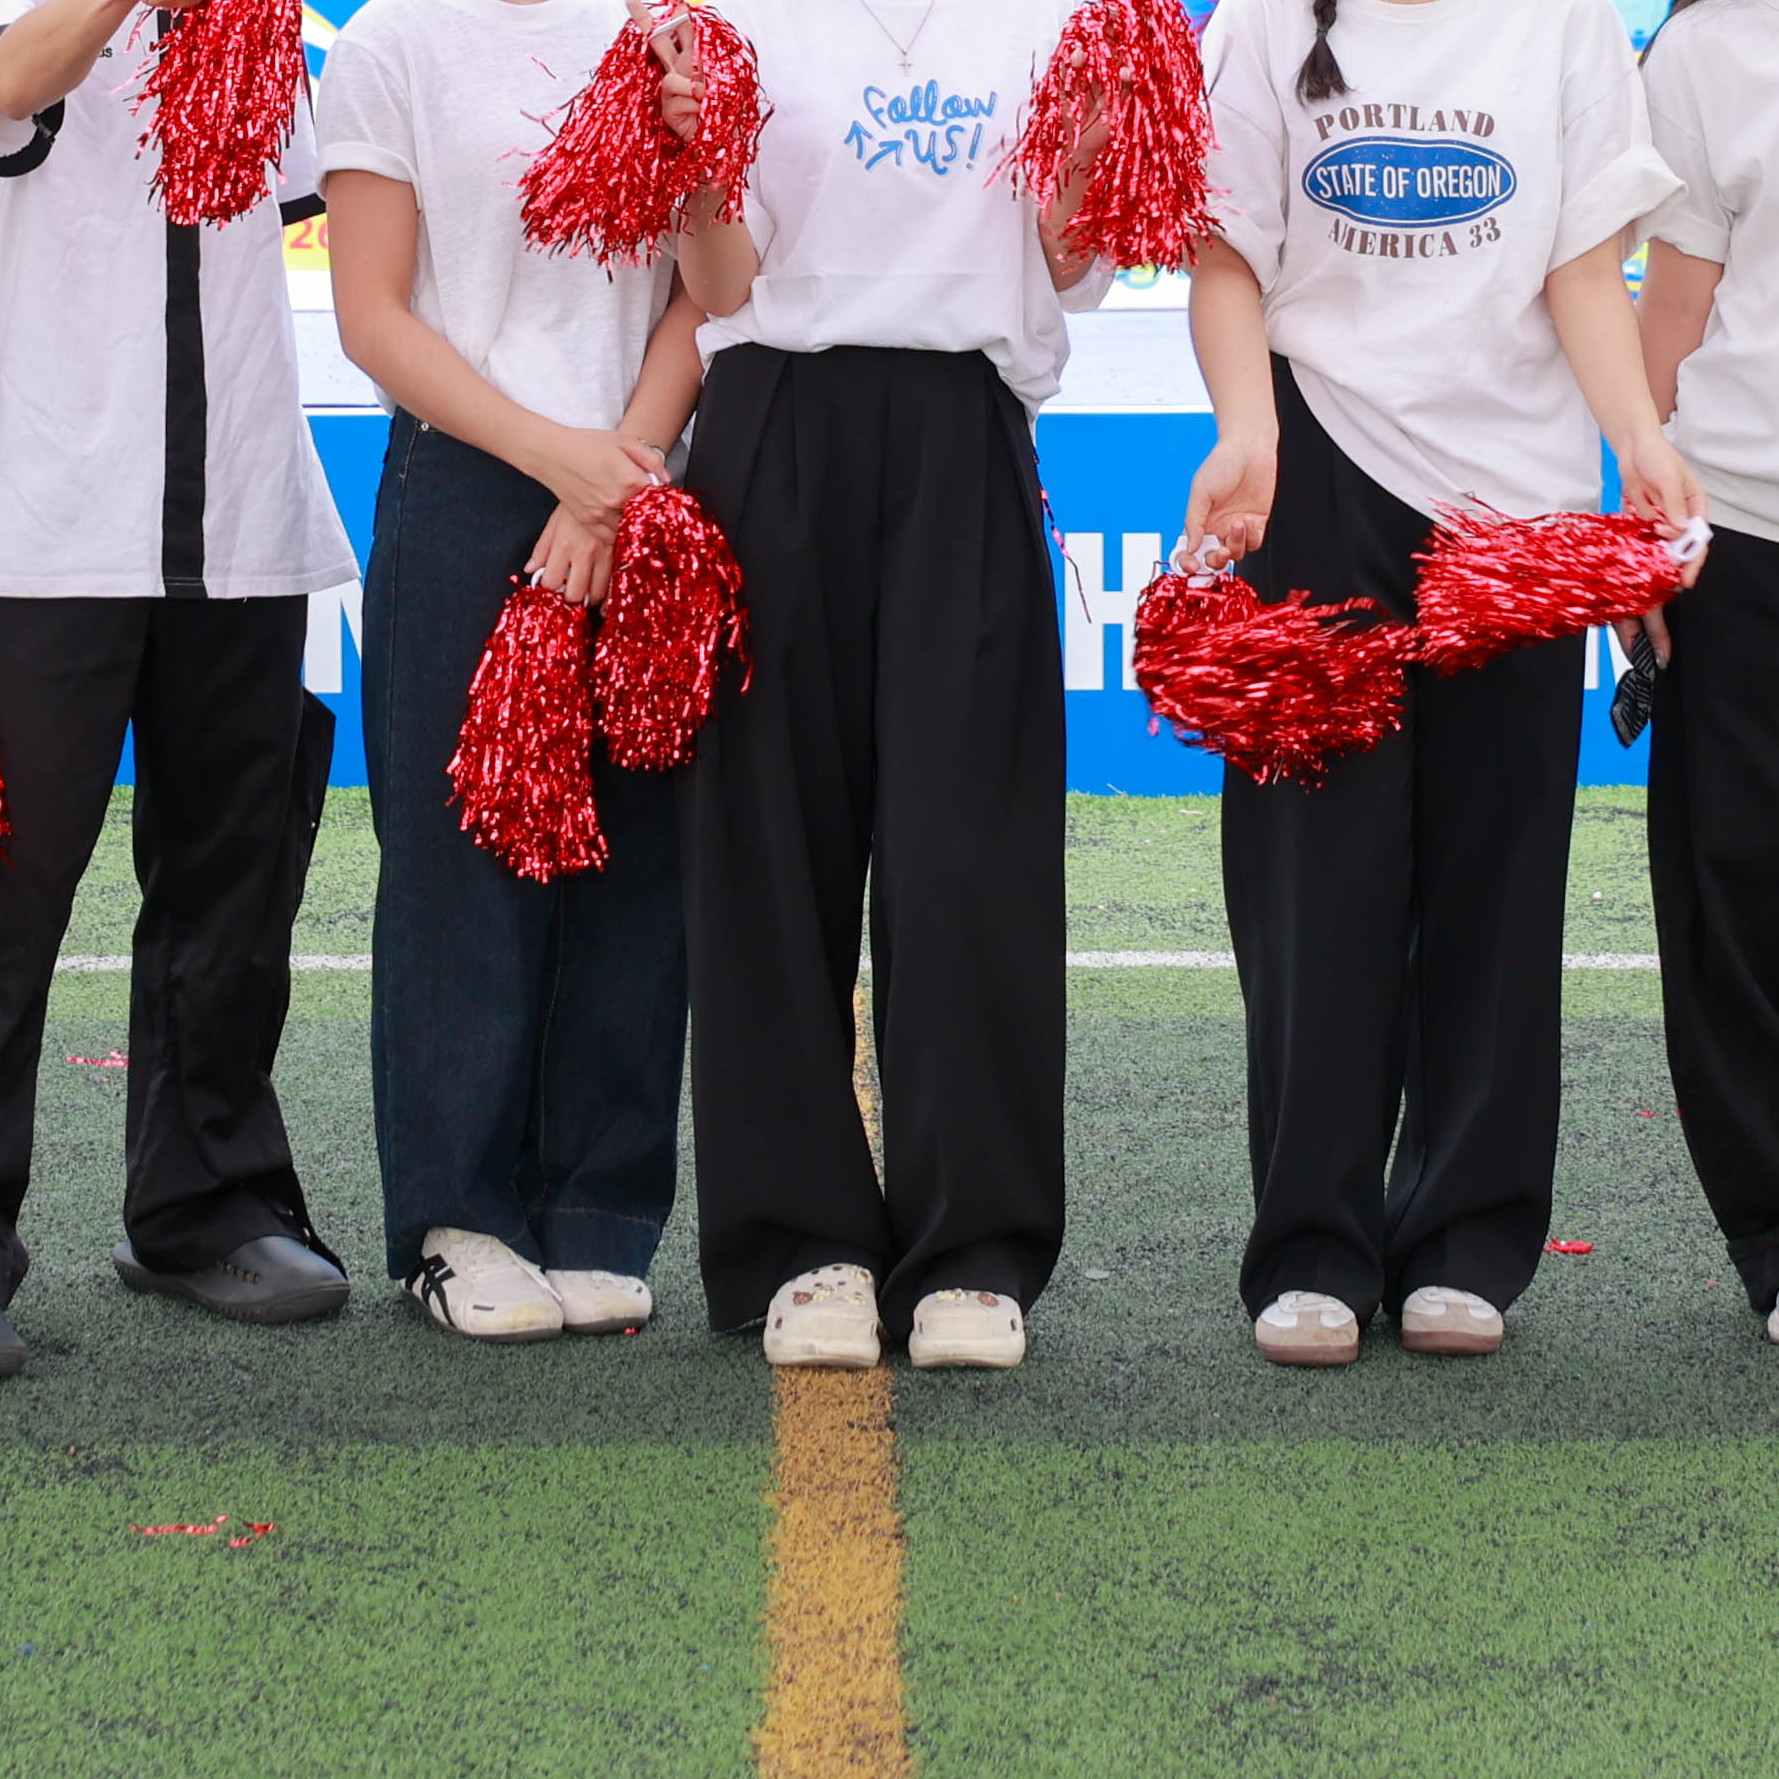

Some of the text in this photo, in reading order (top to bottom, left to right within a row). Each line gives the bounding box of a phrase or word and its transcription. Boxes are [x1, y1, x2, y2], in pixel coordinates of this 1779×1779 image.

[864, 79, 998, 129] Follow
[1315, 103, 1495, 142] PORTLAND
[1316, 165, 1503, 200] STATE OF OREGON
[1468, 217, 1503, 252] 33
